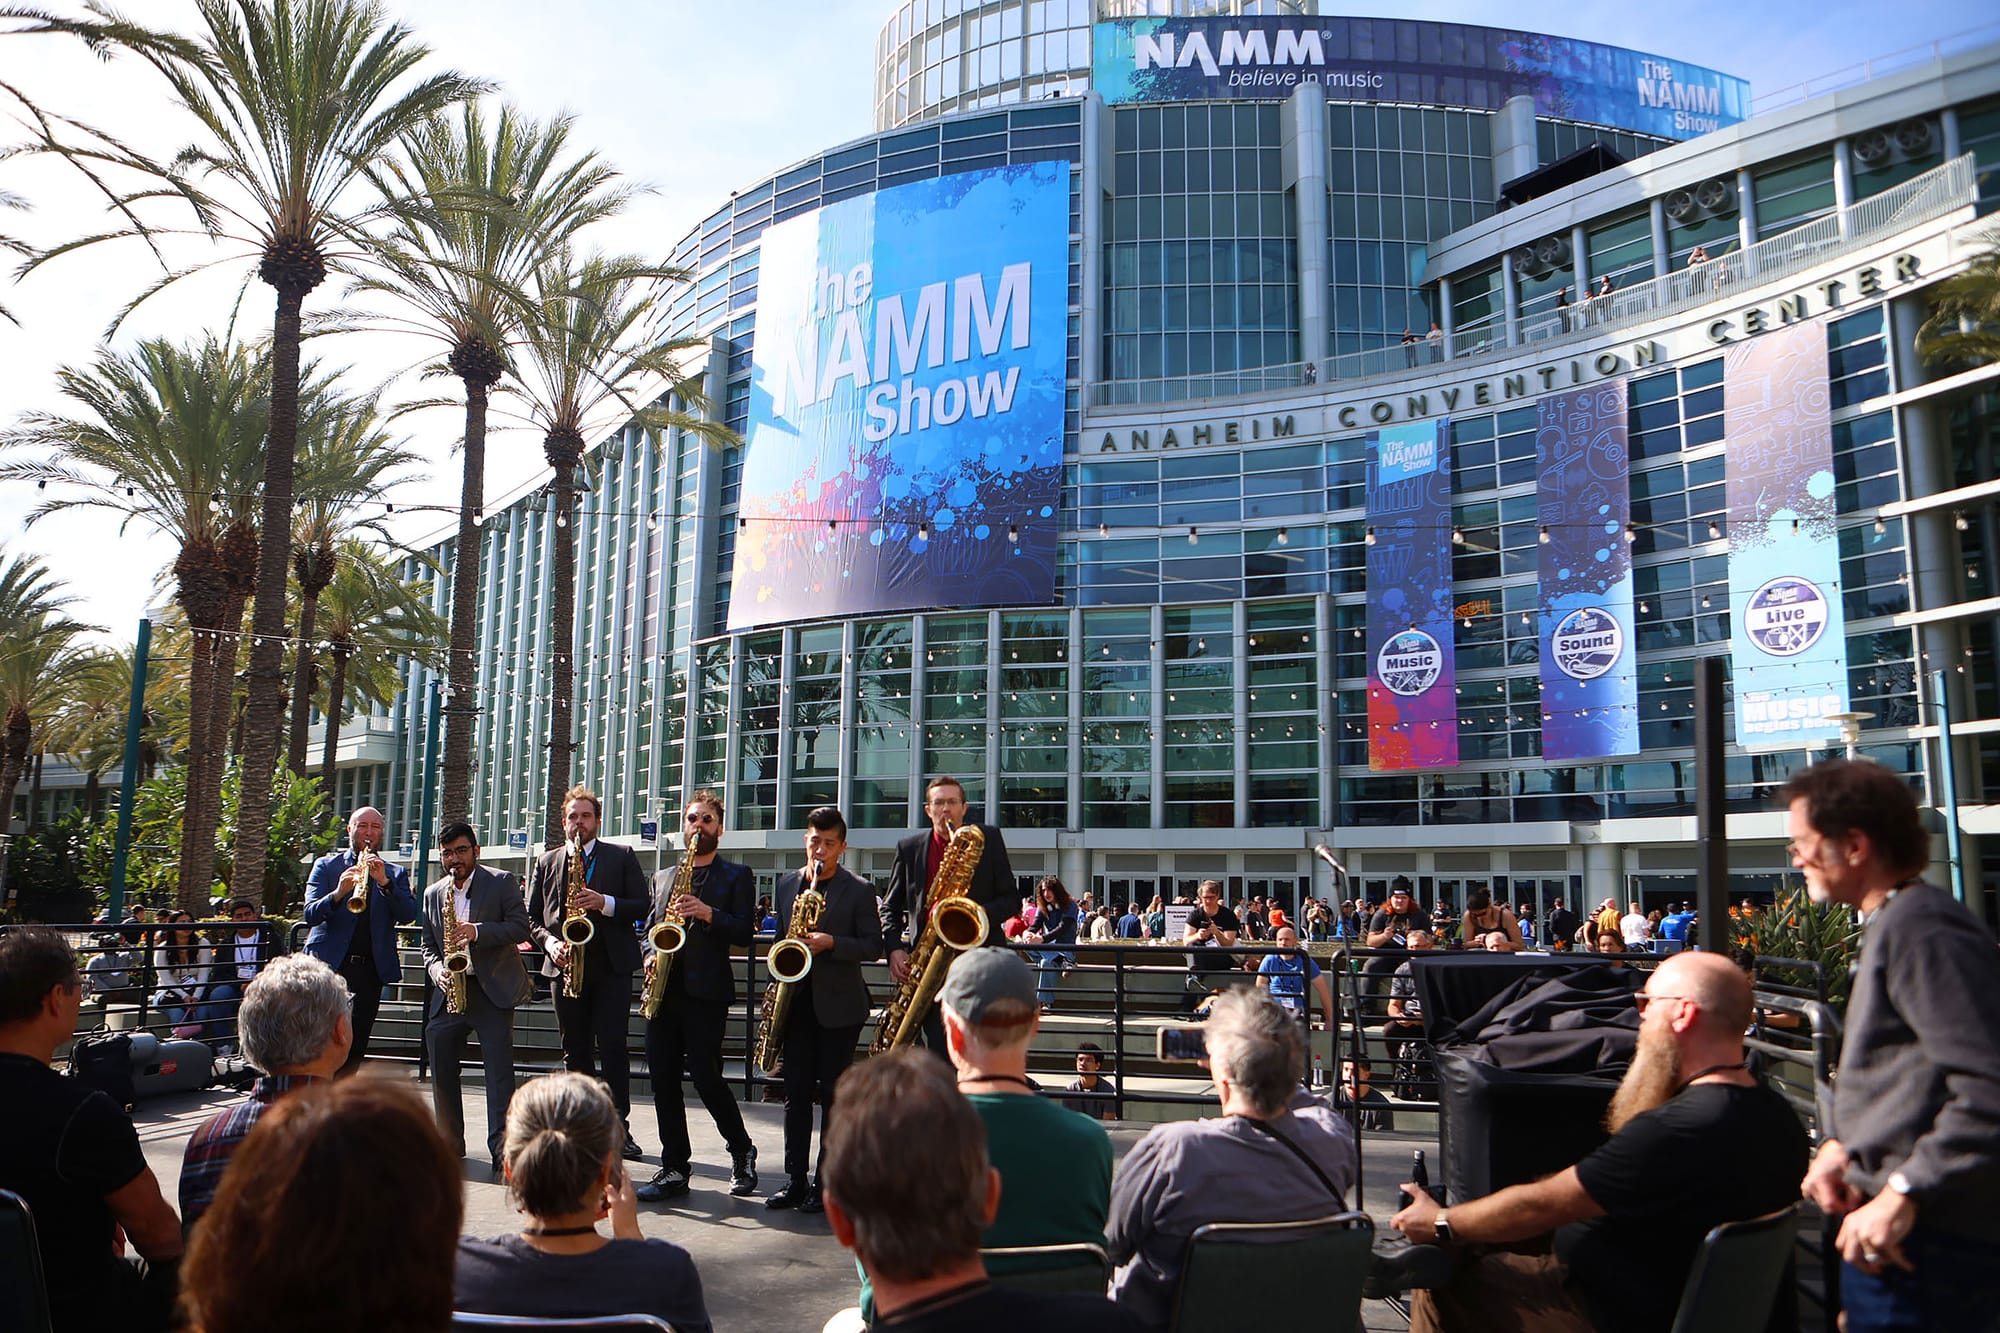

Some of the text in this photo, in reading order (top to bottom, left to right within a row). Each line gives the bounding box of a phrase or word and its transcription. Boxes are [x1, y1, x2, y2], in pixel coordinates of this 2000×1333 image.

[1228, 69, 1383, 88] believe in music
[1641, 59, 1672, 81] The
[1637, 77, 1720, 116] NAMM
[1674, 110, 1719, 132] Show
[798, 262, 873, 327] he
[772, 262, 1031, 419] NAMM
[1100, 252, 1917, 452] ANAHEIM CONVENTION CENTER
[864, 366, 1020, 442] Show
[1382, 440, 1433, 468] NAMM
[1386, 441, 1405, 452] The
[1403, 457, 1432, 472] Show
[1766, 608, 1805, 624] Live
[1560, 634, 1614, 652] Sound
[1386, 655, 1433, 669] Music
[1742, 695, 1842, 722] MUSIC
